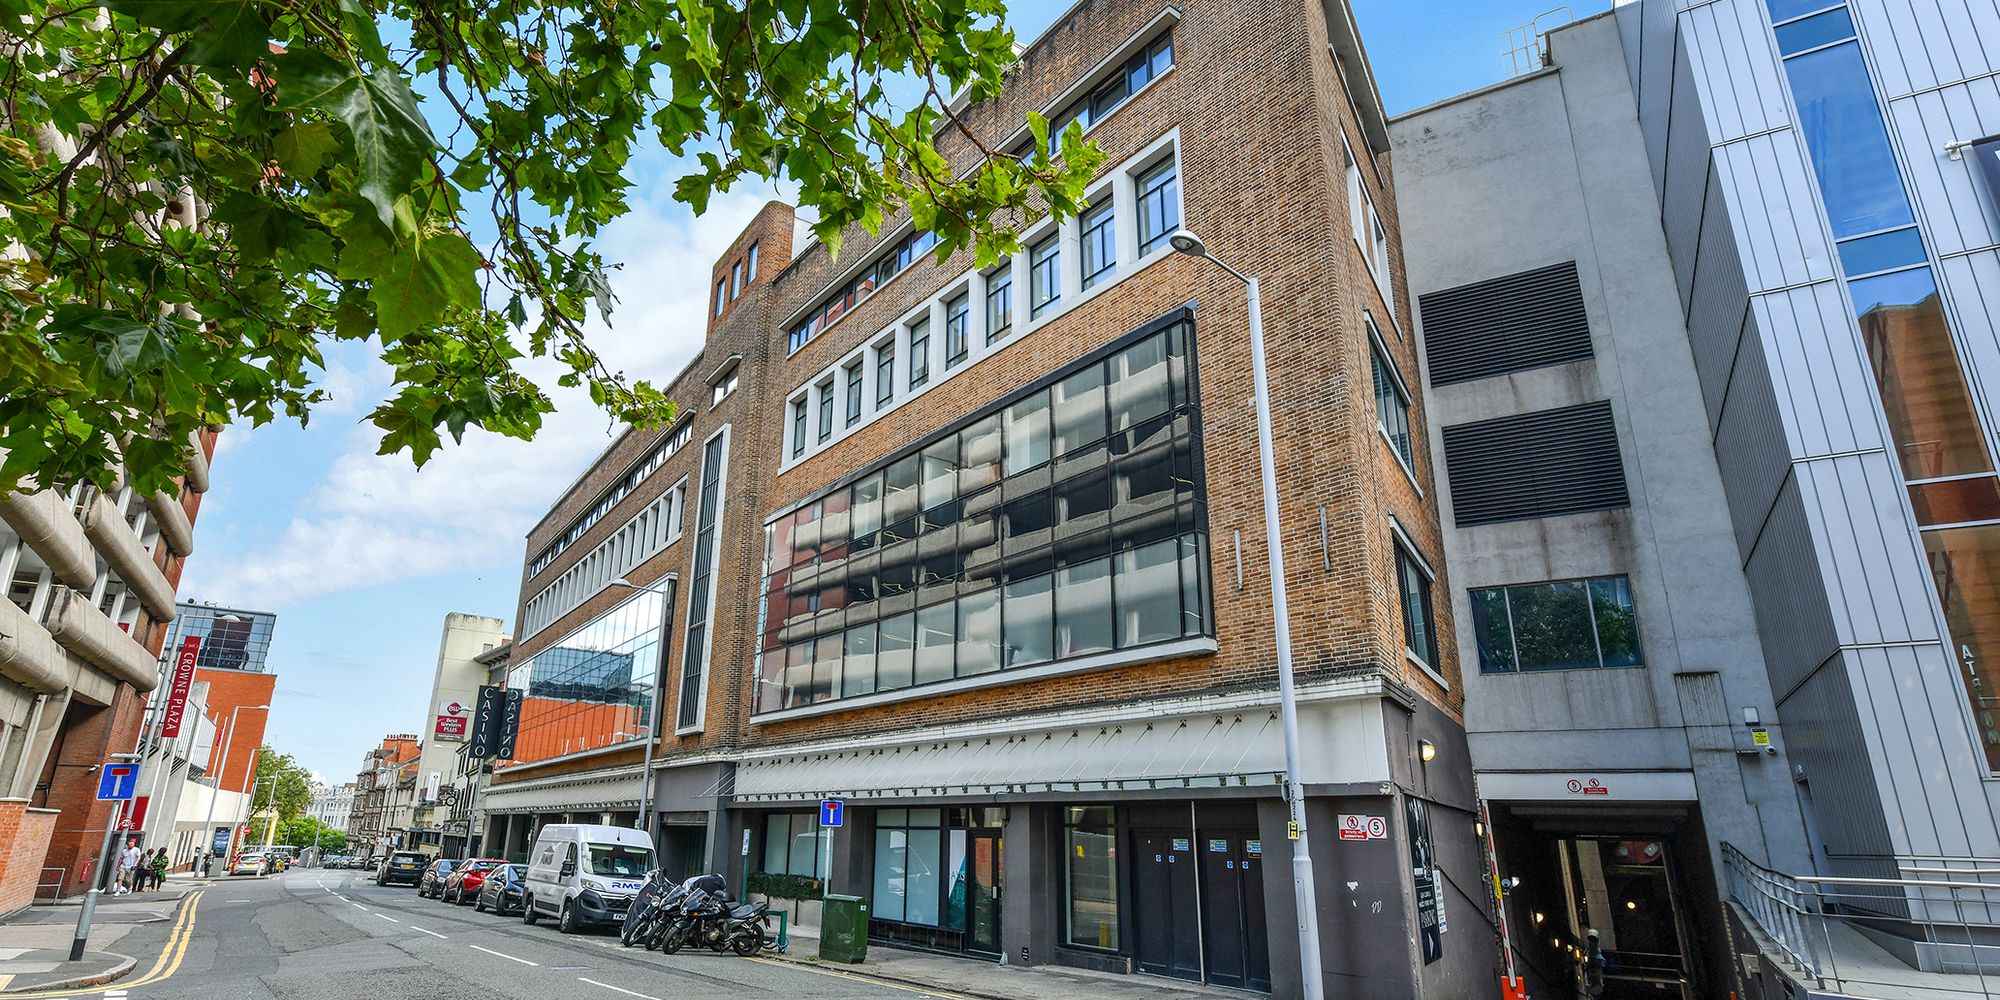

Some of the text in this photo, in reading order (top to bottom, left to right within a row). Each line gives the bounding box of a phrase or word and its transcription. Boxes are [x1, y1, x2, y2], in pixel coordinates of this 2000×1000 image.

[166, 652, 194, 730] CROWNE PLAZA
[475, 687, 494, 757] CASINO
[1373, 821, 1380, 831] 5
[612, 881, 641, 890] RMS
